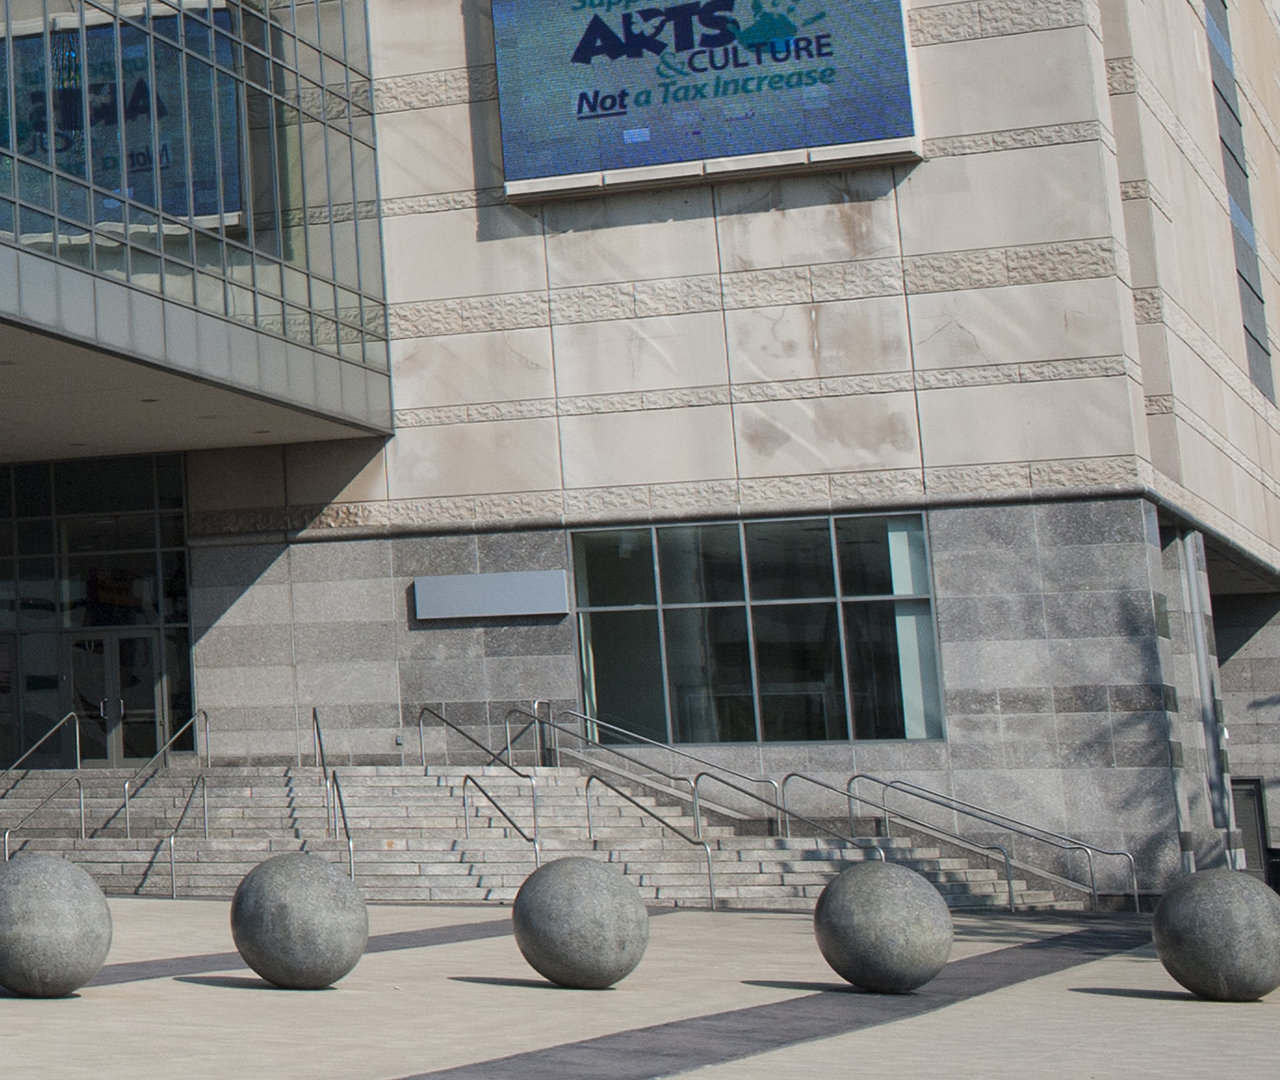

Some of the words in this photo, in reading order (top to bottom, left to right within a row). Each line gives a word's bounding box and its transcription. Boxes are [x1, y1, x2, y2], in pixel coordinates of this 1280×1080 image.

[686, 34, 834, 74] CULTURE
[577, 88, 630, 116] Not
[633, 89, 652, 107] a
[657, 80, 707, 105] Tax
[712, 66, 836, 98] Increase
